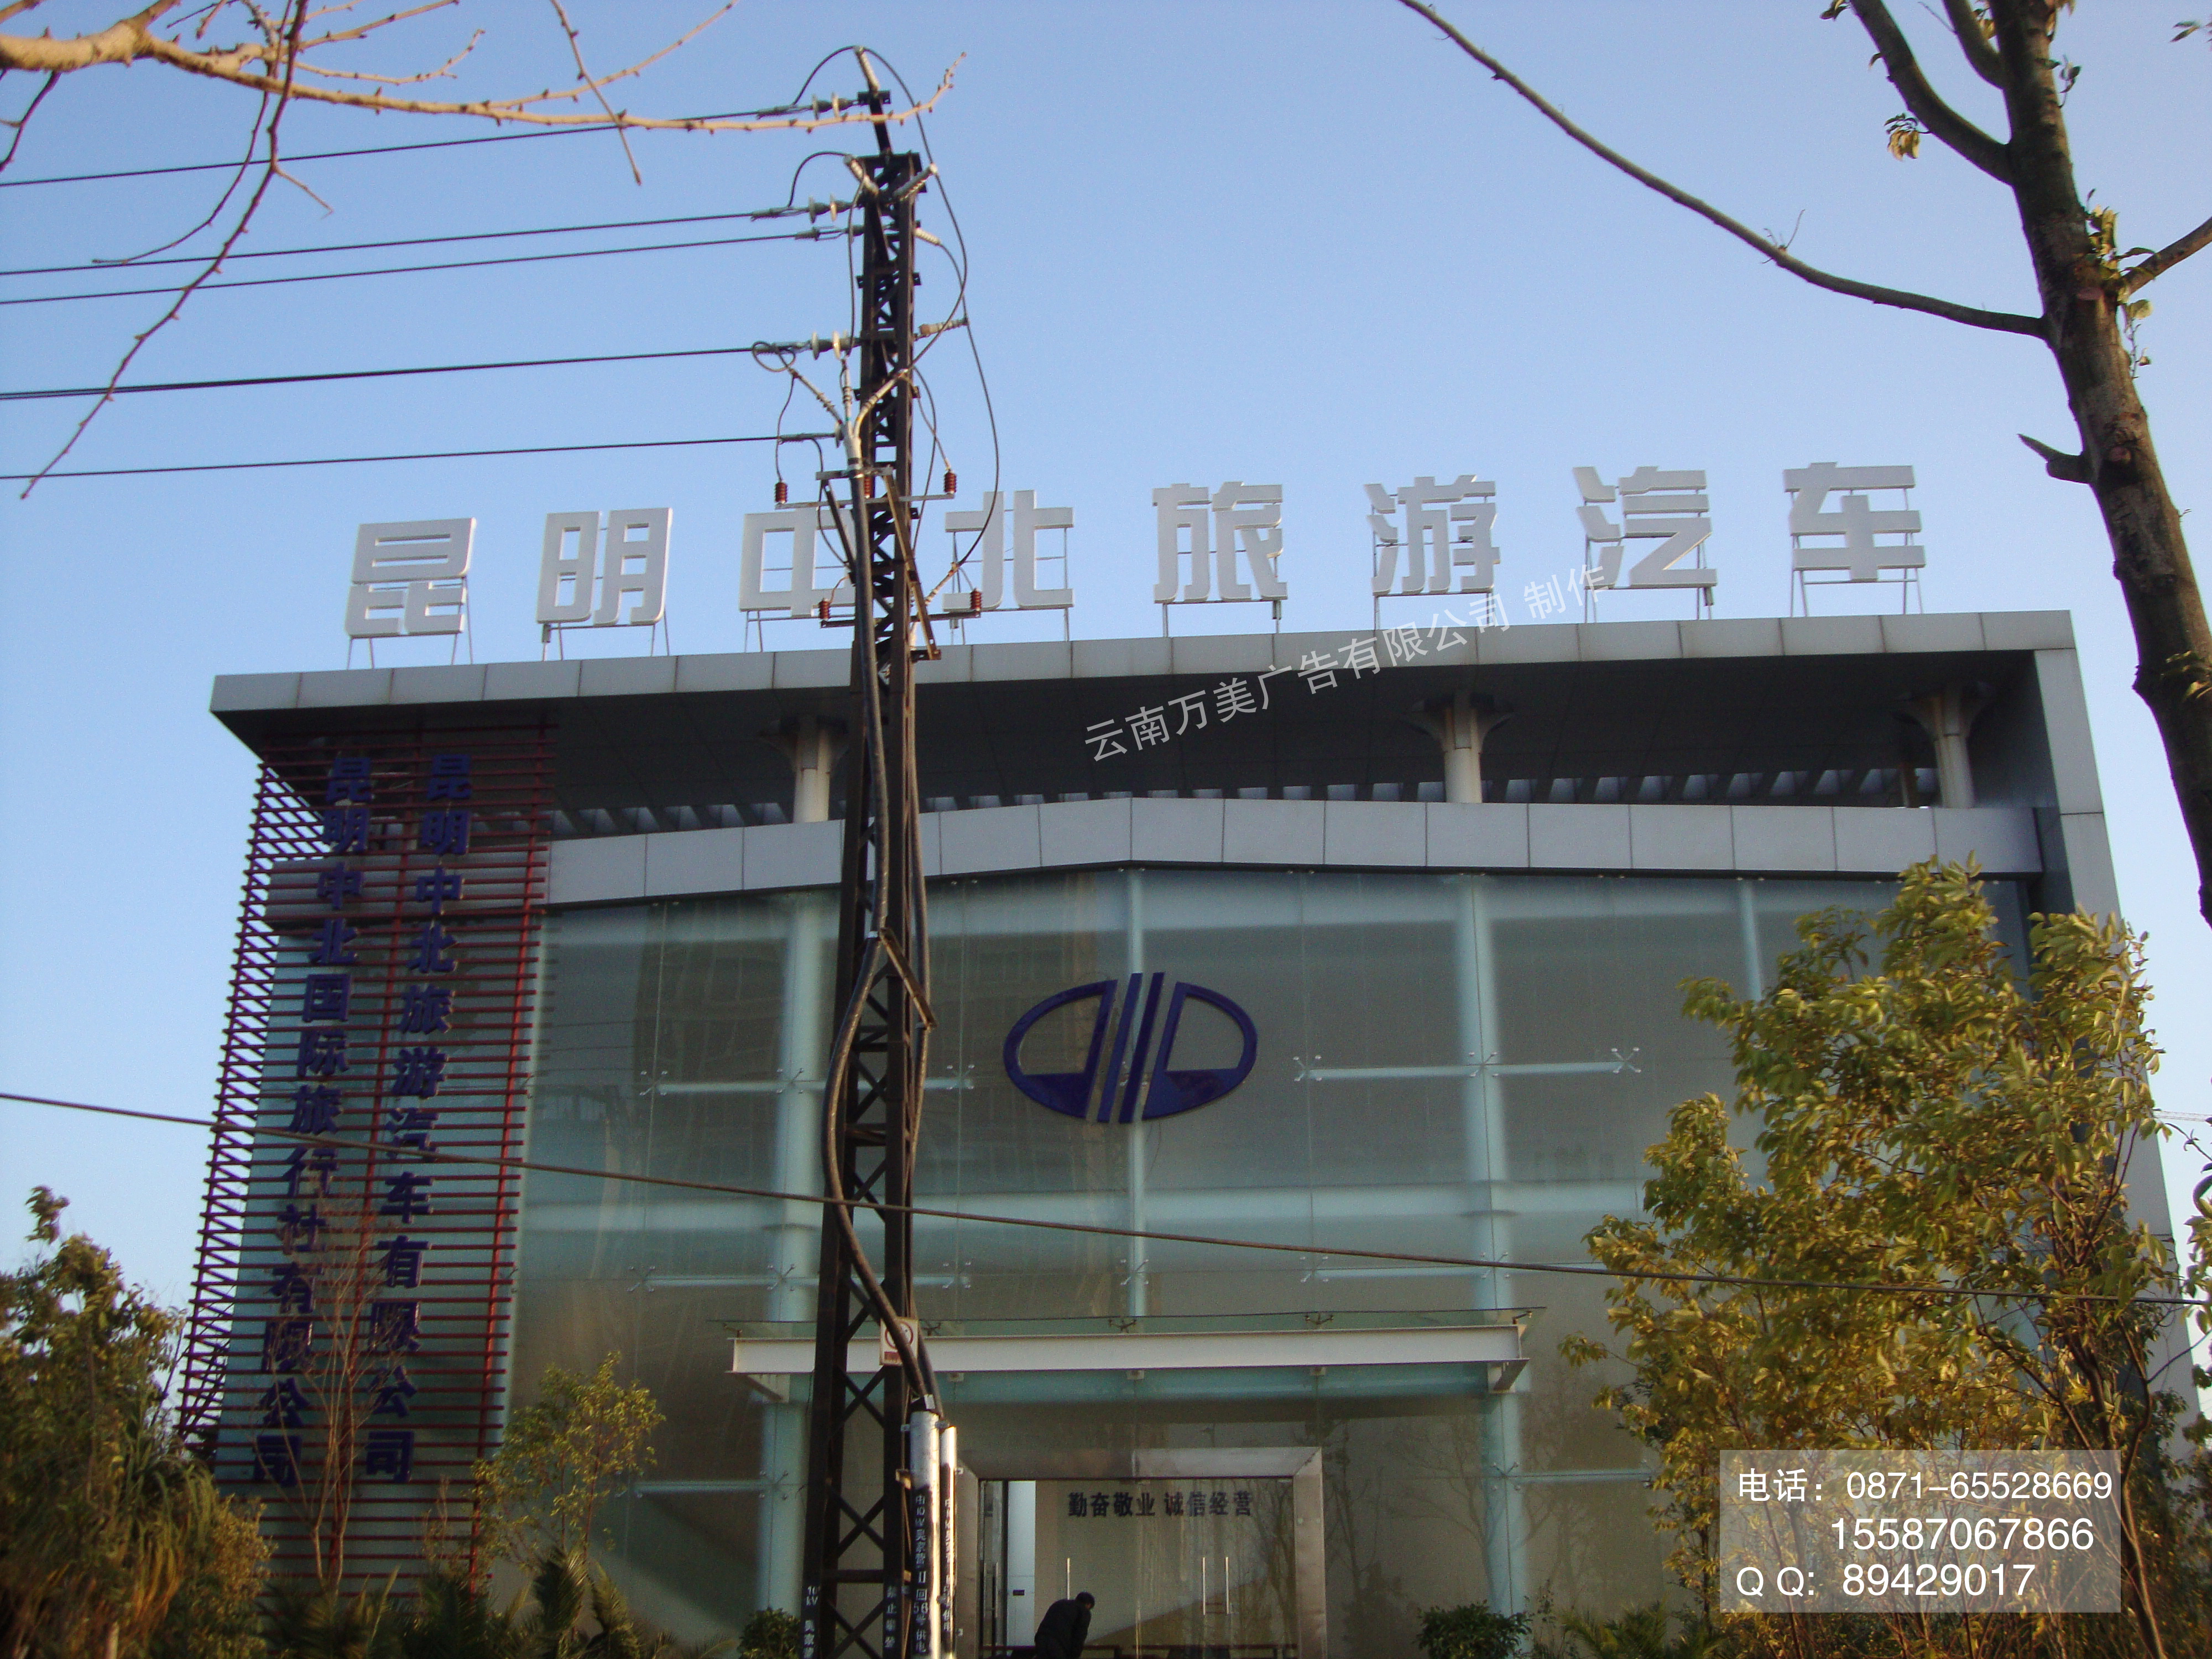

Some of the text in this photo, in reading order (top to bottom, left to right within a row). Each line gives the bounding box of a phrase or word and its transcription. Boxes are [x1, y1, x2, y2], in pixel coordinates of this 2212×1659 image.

[363, 754, 473, 1484] 昆明中北旅游汽车有限公司
[1068, 1490, 1253, 1517] 勤奋敬业 诚信经营
